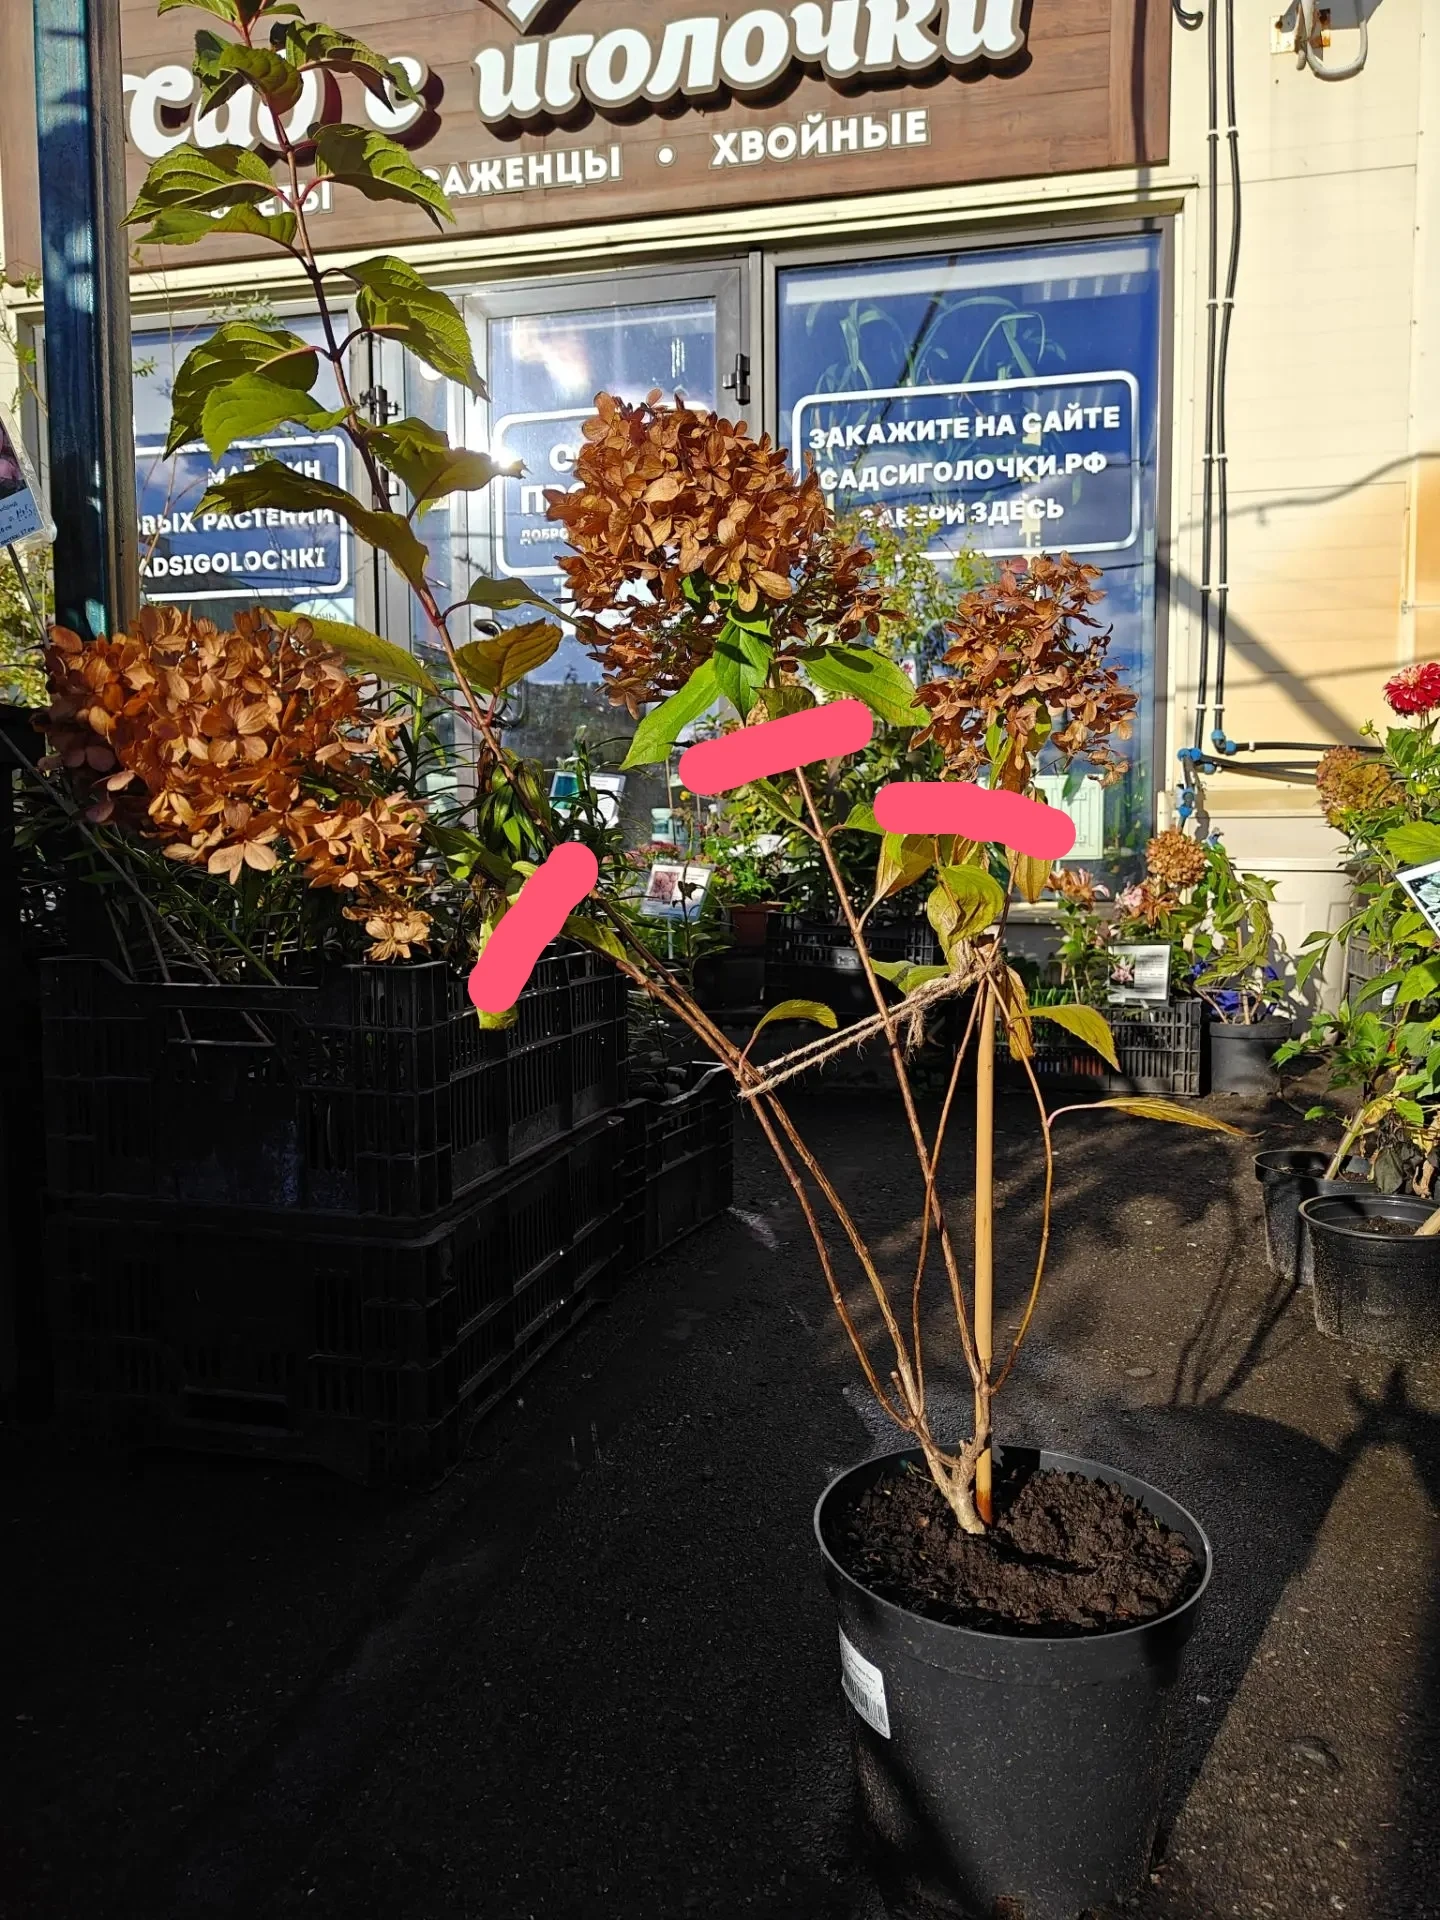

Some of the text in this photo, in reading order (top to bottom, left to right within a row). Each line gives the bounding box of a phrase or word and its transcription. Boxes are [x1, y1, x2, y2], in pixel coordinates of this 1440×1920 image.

[475, 0, 1020, 118] иголочки
[713, 110, 927, 167] ХВОЙНЫЕ
[424, 146, 621, 198] АЖЕНЦЫ
[809, 403, 1121, 449] ЗАКАЖИТЕ НА САЙТЕ
[820, 452, 1107, 492] САДСИГОЛОЧКИ.РФ
[970, 498, 1064, 527] ЗДЕСЬ
